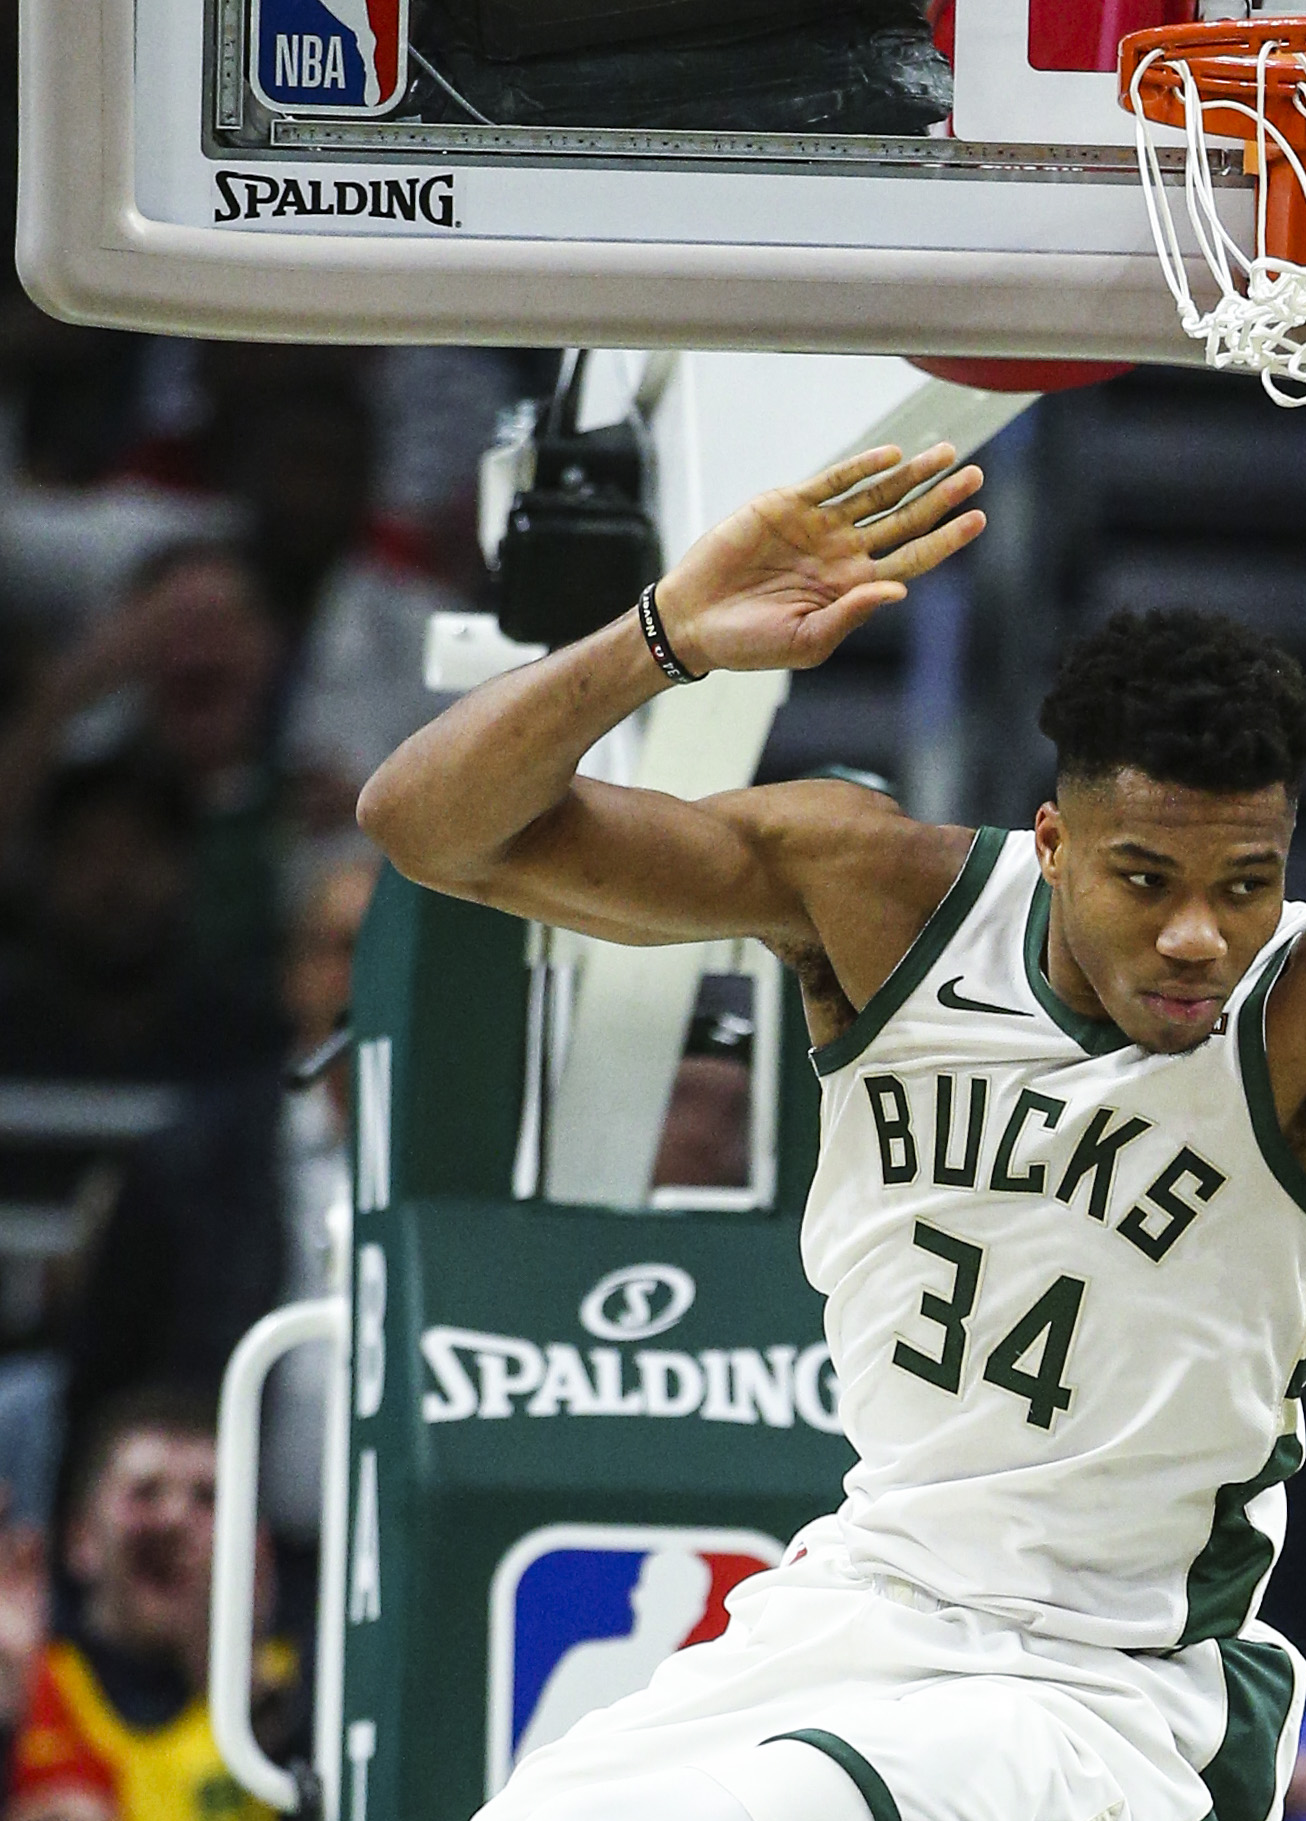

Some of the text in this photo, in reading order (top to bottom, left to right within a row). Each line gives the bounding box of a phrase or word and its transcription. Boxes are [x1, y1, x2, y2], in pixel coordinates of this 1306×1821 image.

[275, 34, 346, 89] NBA
[214, 169, 456, 228] SPALDING
[642, 596, 657, 638] Never
[863, 1073, 1229, 1265] BUCKS
[891, 1217, 1088, 1432] 34
[420, 1324, 846, 1436] SPALDING
